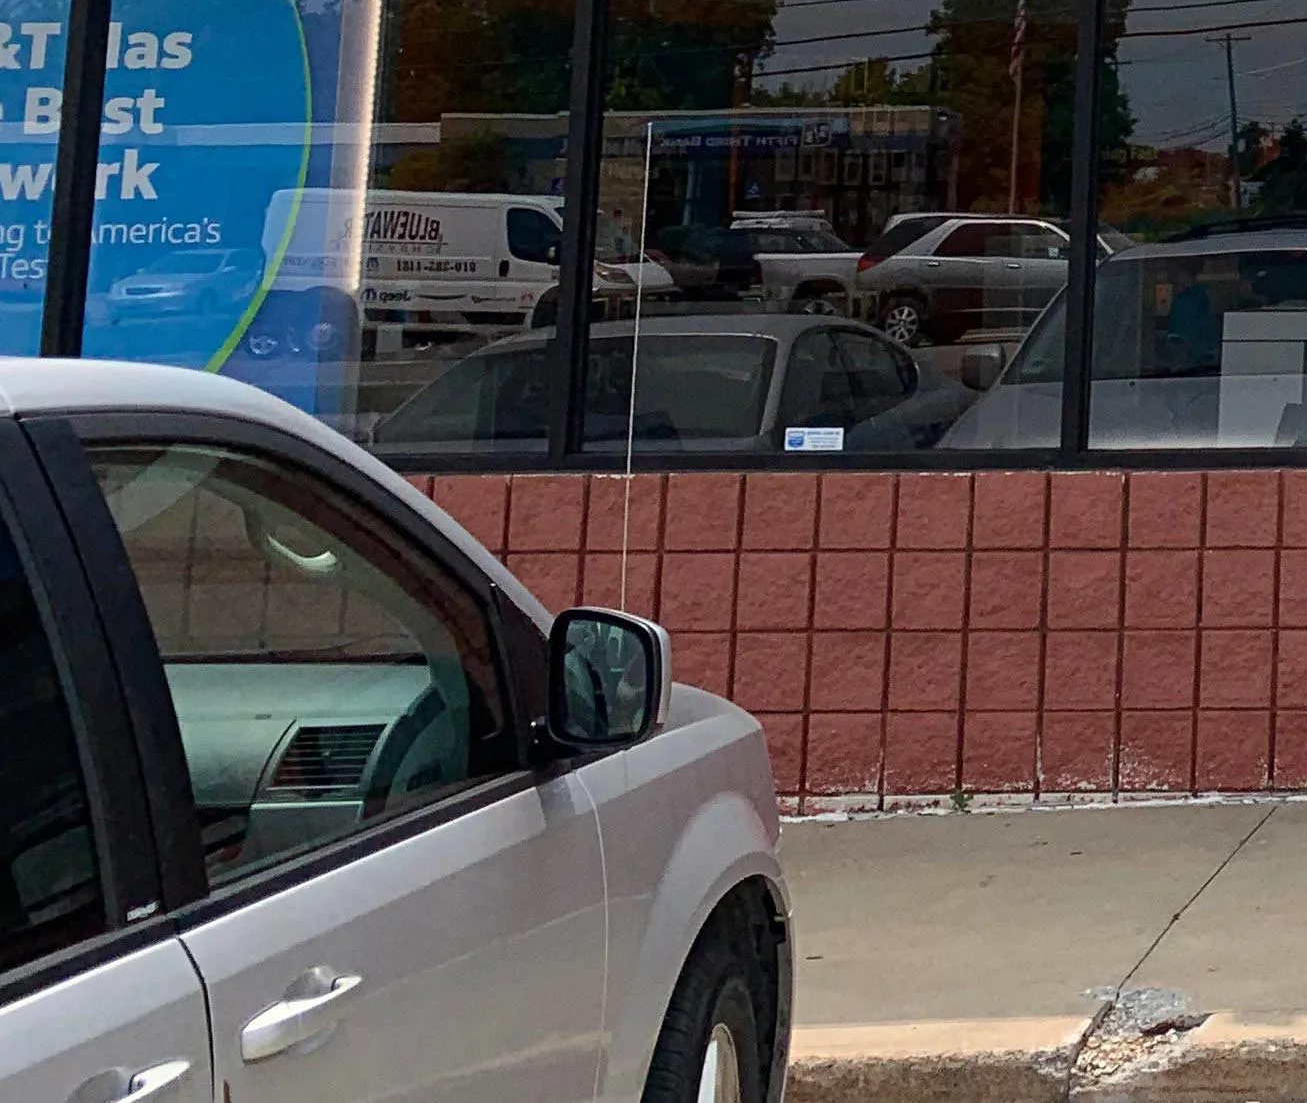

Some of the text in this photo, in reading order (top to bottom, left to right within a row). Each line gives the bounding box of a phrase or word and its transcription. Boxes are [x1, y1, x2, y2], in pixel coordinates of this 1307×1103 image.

[23, 87, 165, 135] Bst
[0, 149, 161, 201] wrk
[91, 216, 221, 244] merica's
